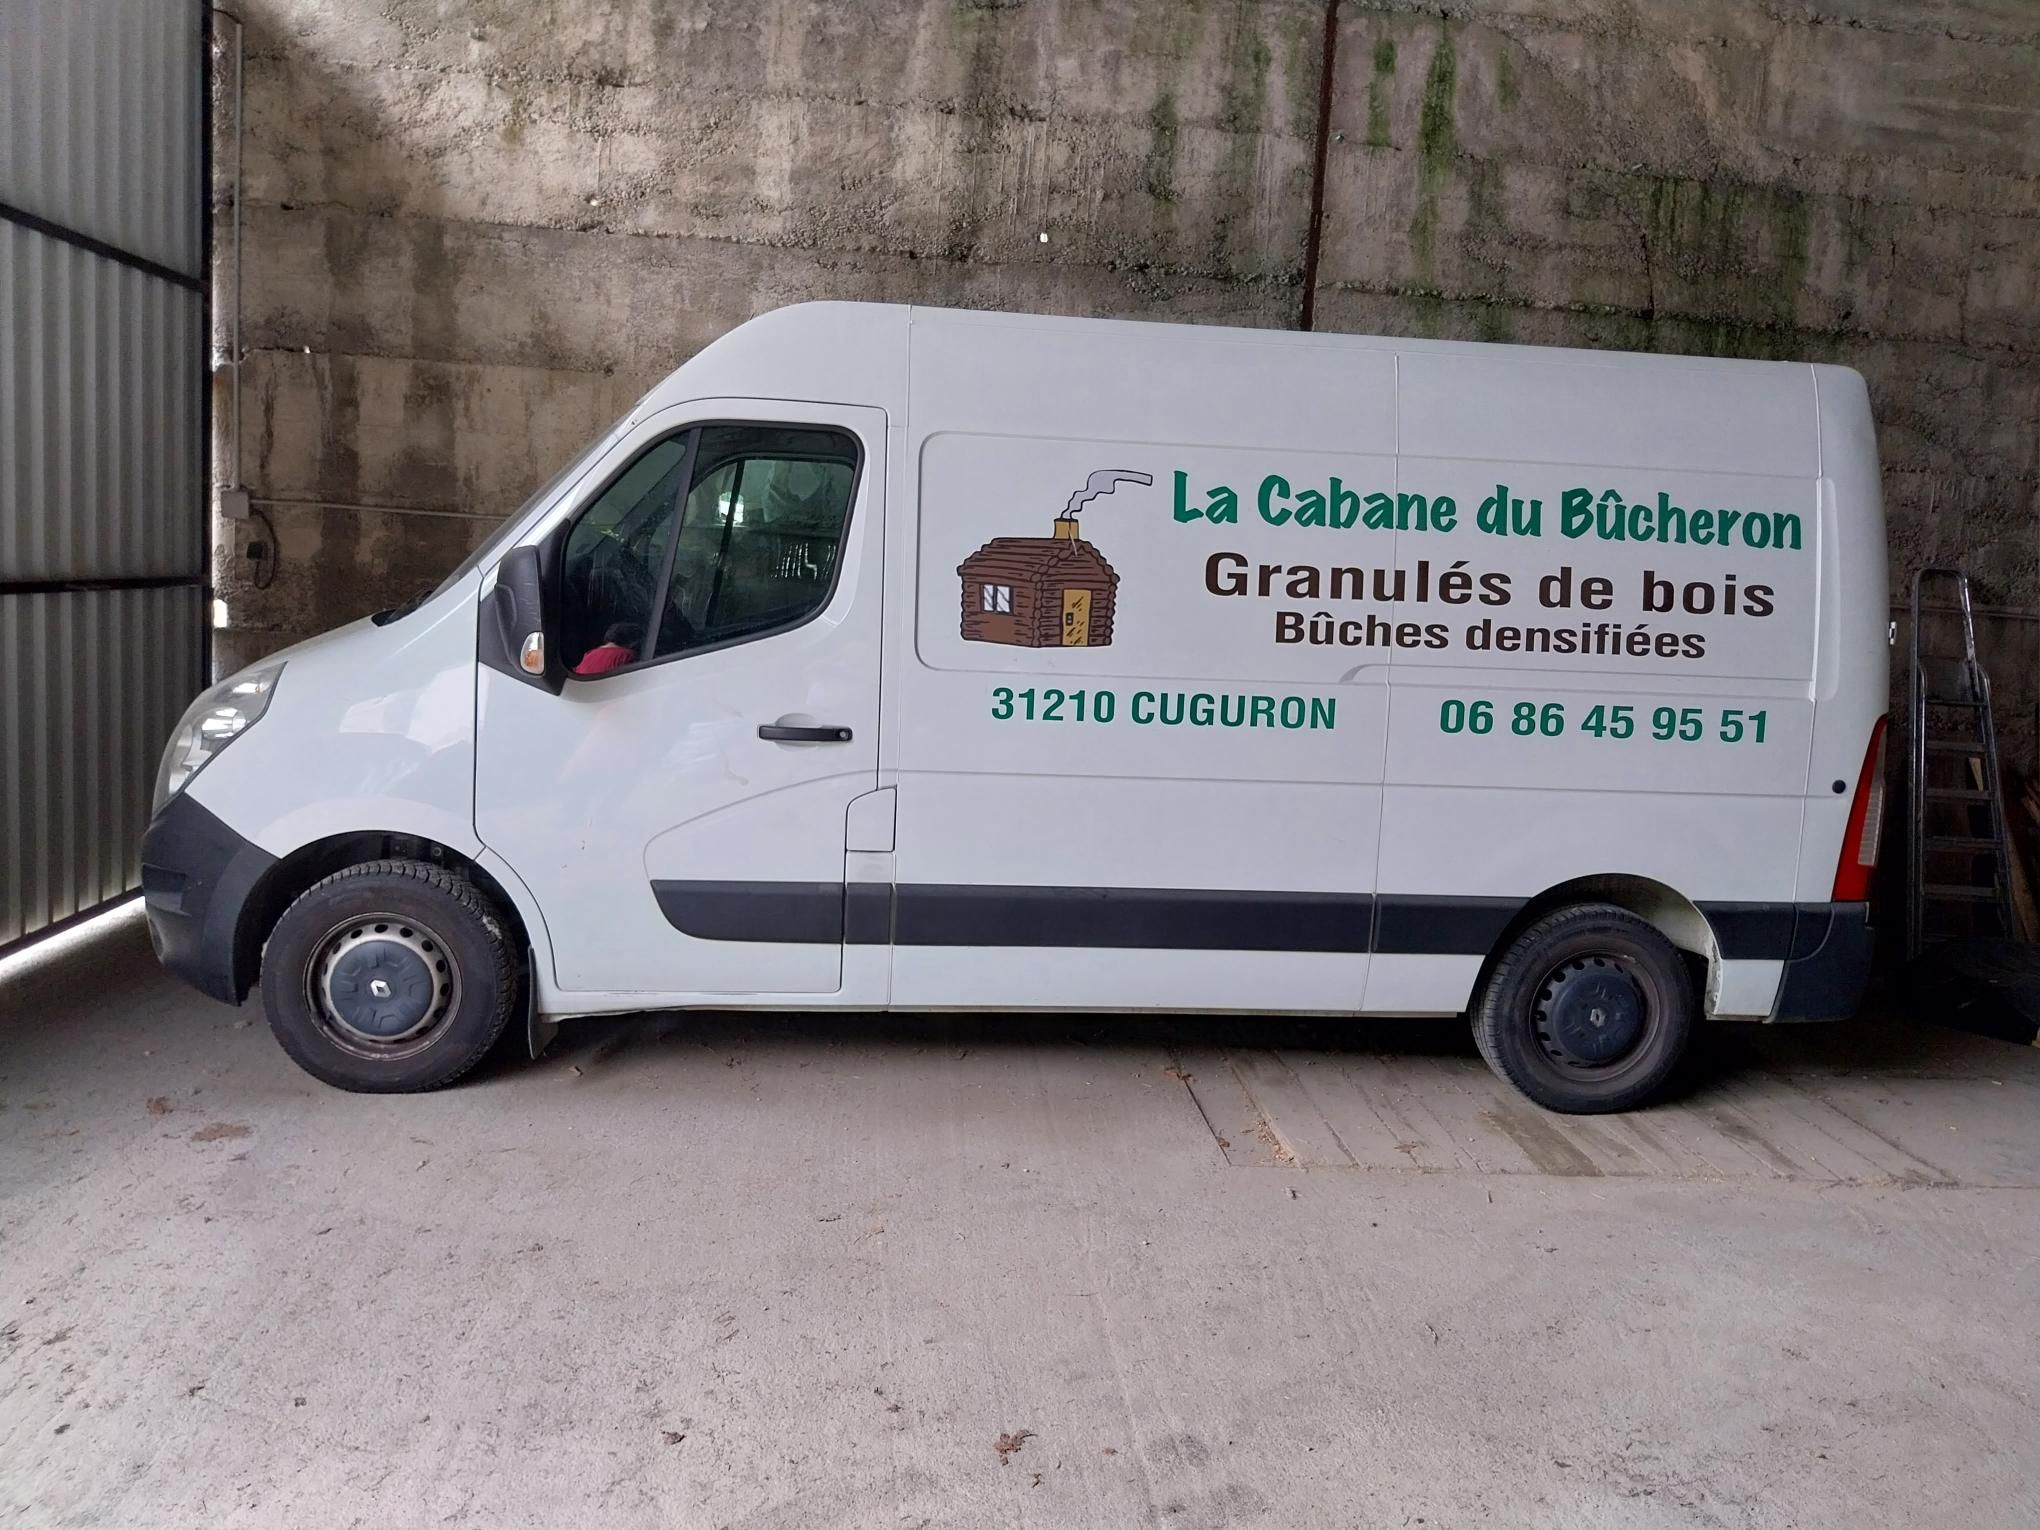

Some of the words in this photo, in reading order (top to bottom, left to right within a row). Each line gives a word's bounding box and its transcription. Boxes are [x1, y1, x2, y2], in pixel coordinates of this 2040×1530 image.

[1173, 470, 1238, 525] La
[1257, 474, 1458, 533] Cabane
[1476, 484, 1543, 538] du
[1560, 487, 1802, 551] Bûcheron
[1205, 551, 1512, 606] Granulés
[1538, 566, 1614, 610] de
[1642, 570, 1775, 617] bois
[1275, 611, 1450, 649] Bûches
[1465, 618, 1706, 659] densifiées
[991, 687, 1116, 724] 31210
[1131, 691, 1336, 730] CUGURON
[1439, 699, 1494, 735] 06
[1511, 701, 1565, 737] 86
[1580, 704, 1635, 739] 45
[1652, 706, 1703, 742] 95
[1719, 709, 1767, 744] 51
